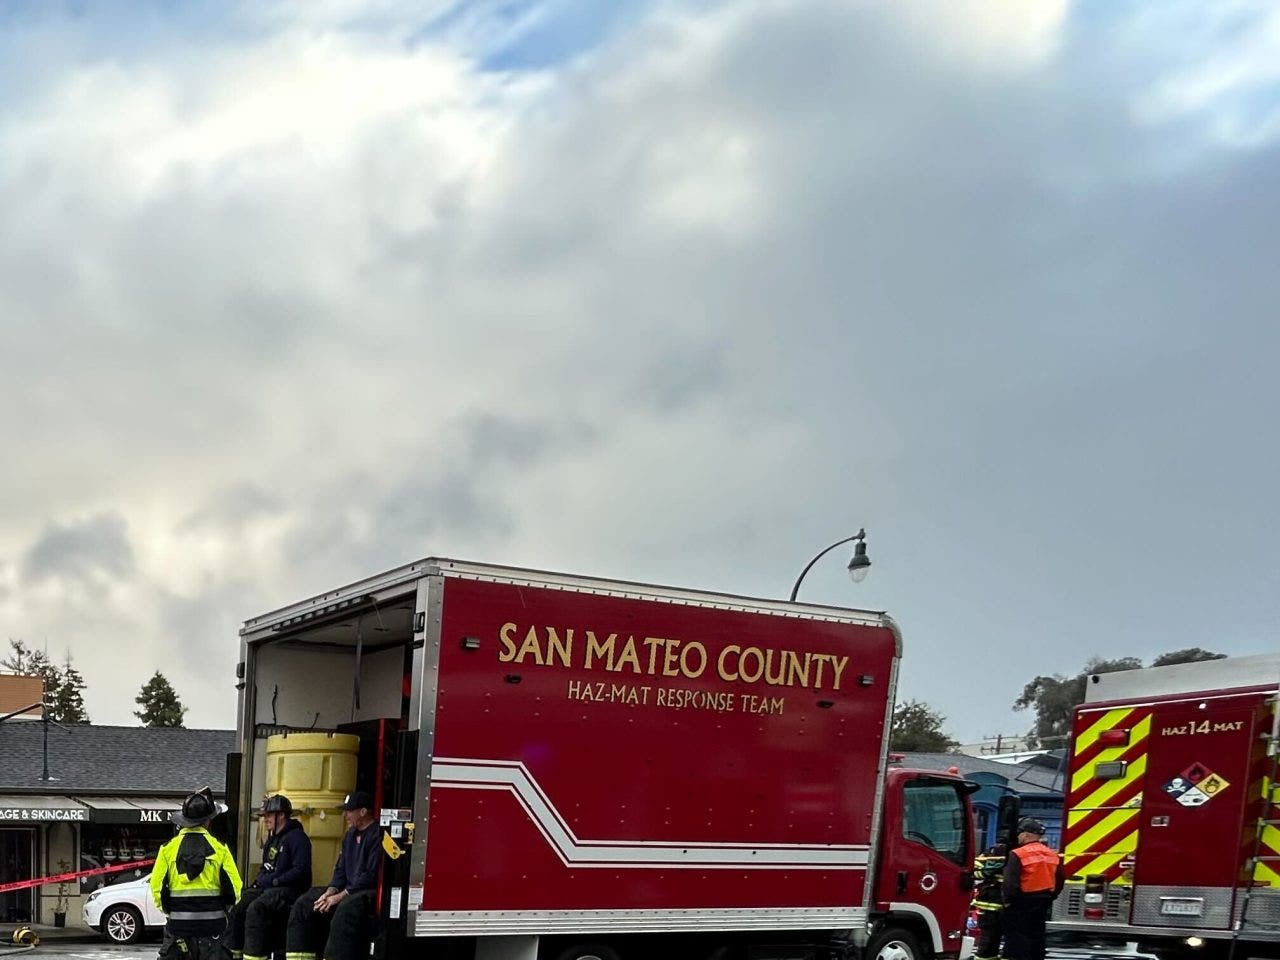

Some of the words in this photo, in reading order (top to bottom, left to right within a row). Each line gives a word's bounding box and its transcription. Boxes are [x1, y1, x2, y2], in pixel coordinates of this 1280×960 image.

[498, 621, 574, 668] SAN
[583, 630, 708, 679] MATEO
[717, 644, 850, 690] COUNTY
[567, 680, 651, 705] HAZ-MAT
[657, 687, 734, 712] RESPONSE
[740, 694, 785, 716] TEAM
[1161, 726, 1187, 736] HAZ
[1188, 720, 1211, 735] 14
[1213, 721, 1244, 732] MAT
[21, 810, 29, 819] &
[31, 809, 85, 820] SKINCARE
[140, 810, 163, 822] MK
